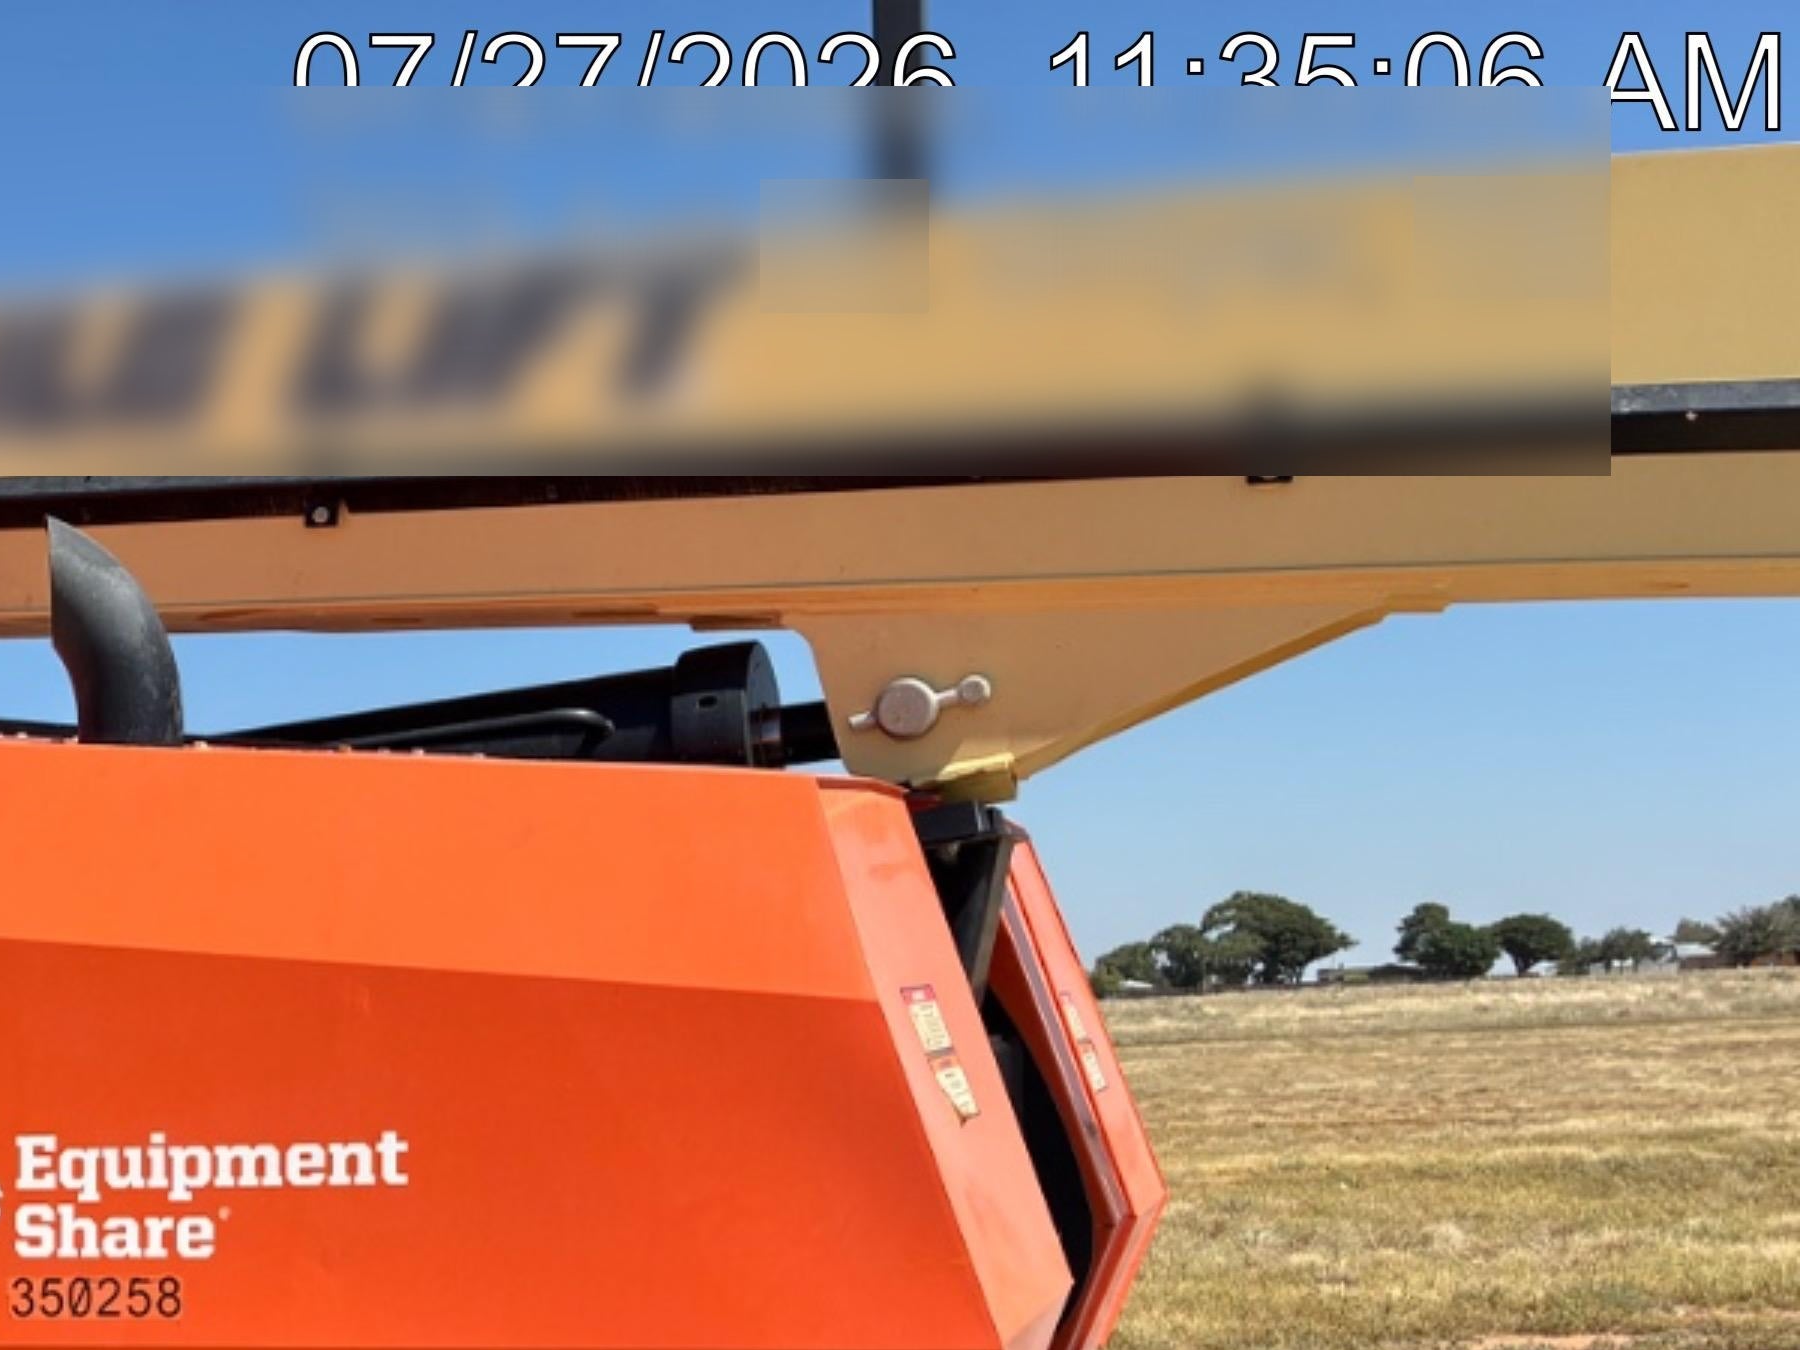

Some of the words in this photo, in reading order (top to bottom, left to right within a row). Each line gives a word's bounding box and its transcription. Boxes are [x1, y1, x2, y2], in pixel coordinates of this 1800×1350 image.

[14, 1130, 409, 1202] Equipment
[14, 1203, 217, 1259] Share
[10, 1276, 183, 1319] 350258
